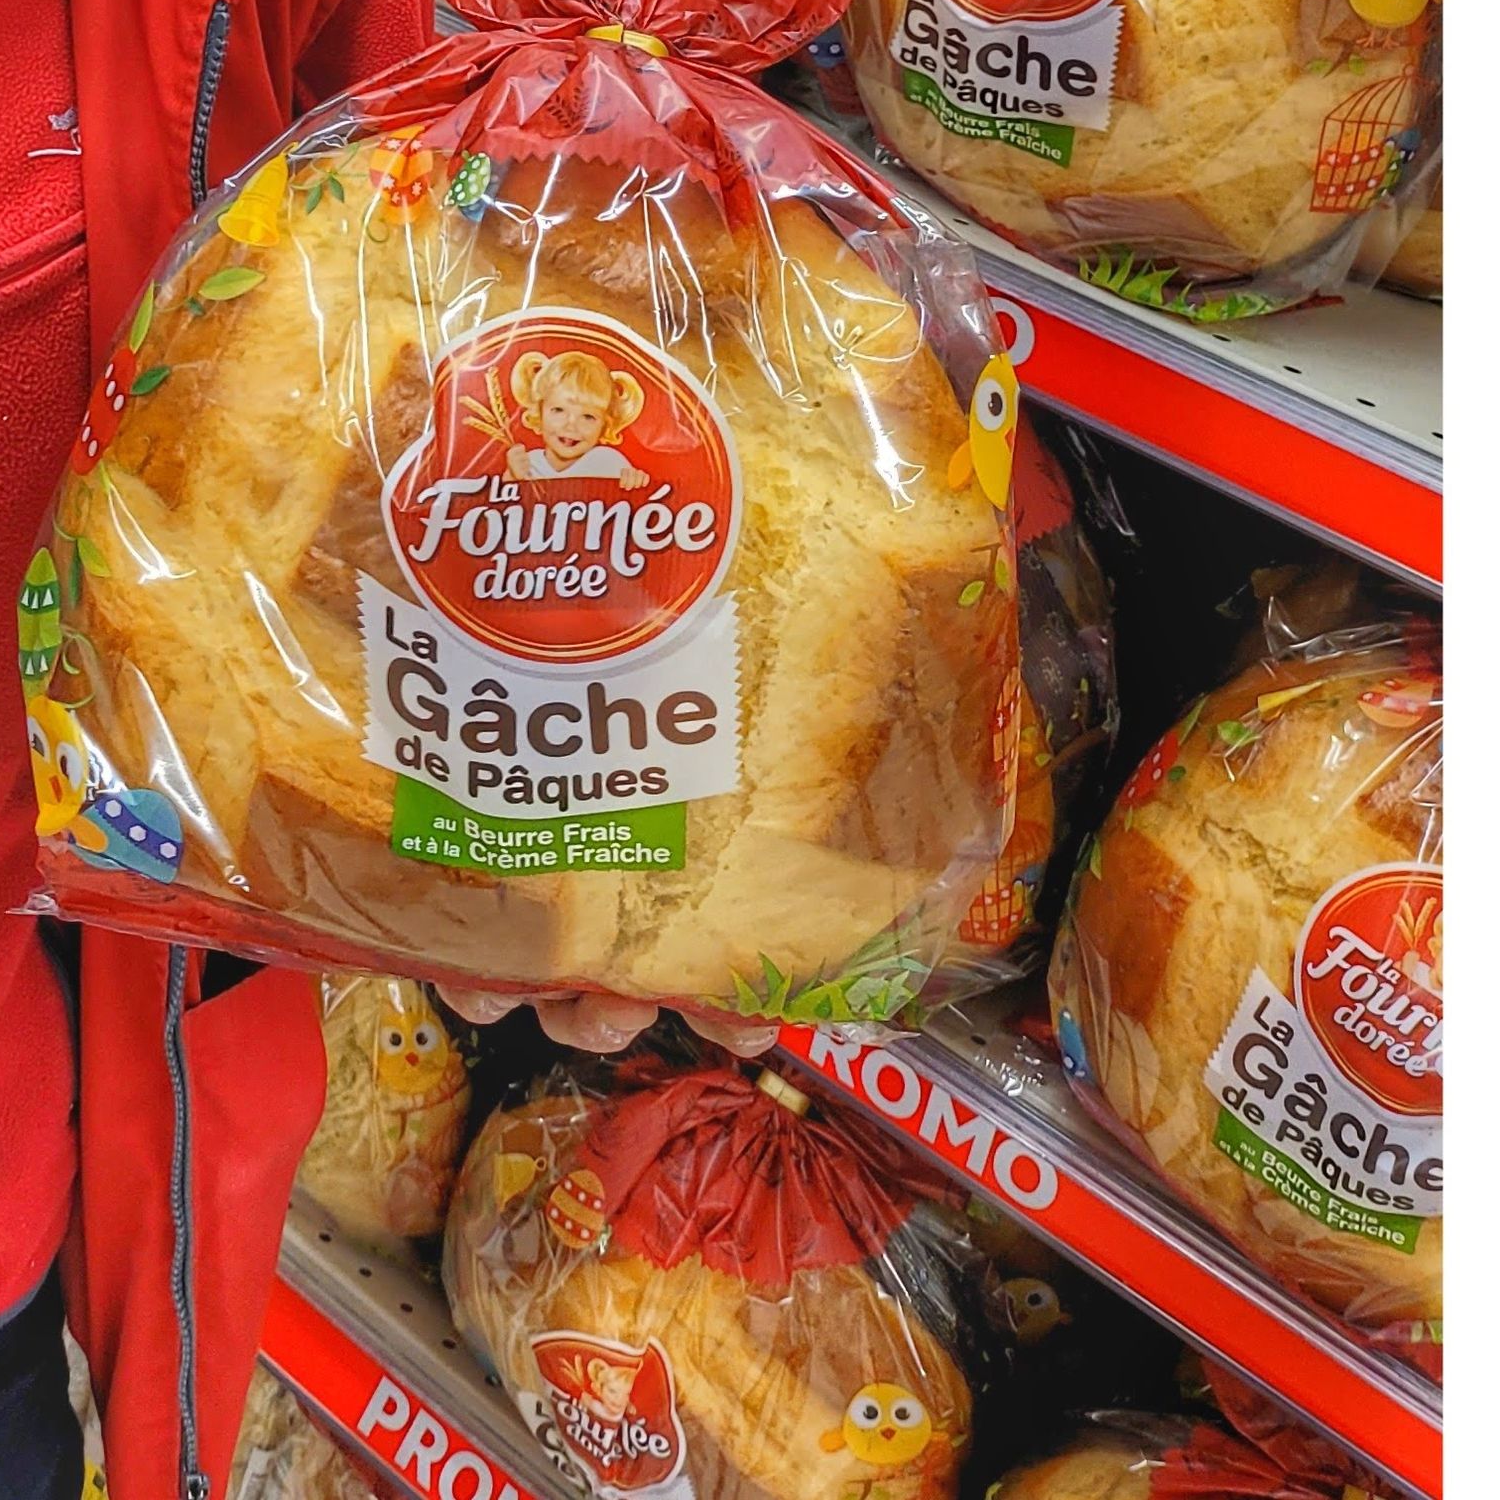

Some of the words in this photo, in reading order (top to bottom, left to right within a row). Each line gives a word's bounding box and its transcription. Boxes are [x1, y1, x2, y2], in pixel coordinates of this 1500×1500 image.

[899, 45, 938, 75] de
[942, 69, 1065, 119] Pâques
[903, 0, 1098, 98] Gâche
[995, 117, 1041, 139] Frais
[999, 127, 1063, 161] Fraîche
[407, 474, 716, 577] Fournée
[489, 474, 521, 503] la
[472, 552, 609, 600] dorée
[385, 605, 439, 664] La
[386, 656, 718, 759] Gâche
[394, 734, 451, 783] de
[467, 759, 670, 813] Pâques
[401, 836, 423, 853] et
[425, 836, 440, 854] à
[443, 840, 461, 859] la
[469, 845, 558, 870] Crème
[566, 843, 672, 865] Fraîche
[433, 815, 457, 833] au
[463, 817, 554, 848] Beurre
[563, 821, 632, 843] Frais
[1377, 958, 1401, 985] la
[1253, 995, 1295, 1048] La
[1332, 1002, 1429, 1078] dorée
[809, 1028, 1059, 1211] ROMO
[1221, 1085, 1266, 1126] de
[1274, 1119, 1415, 1211] Pâques
[1232, 1032, 1443, 1192] Gâche
[1261, 1150, 1323, 1203] Beurre
[1327, 1197, 1379, 1225] Frais
[1261, 1166, 1321, 1216] Crème
[1326, 1213, 1406, 1246] Fraîche
